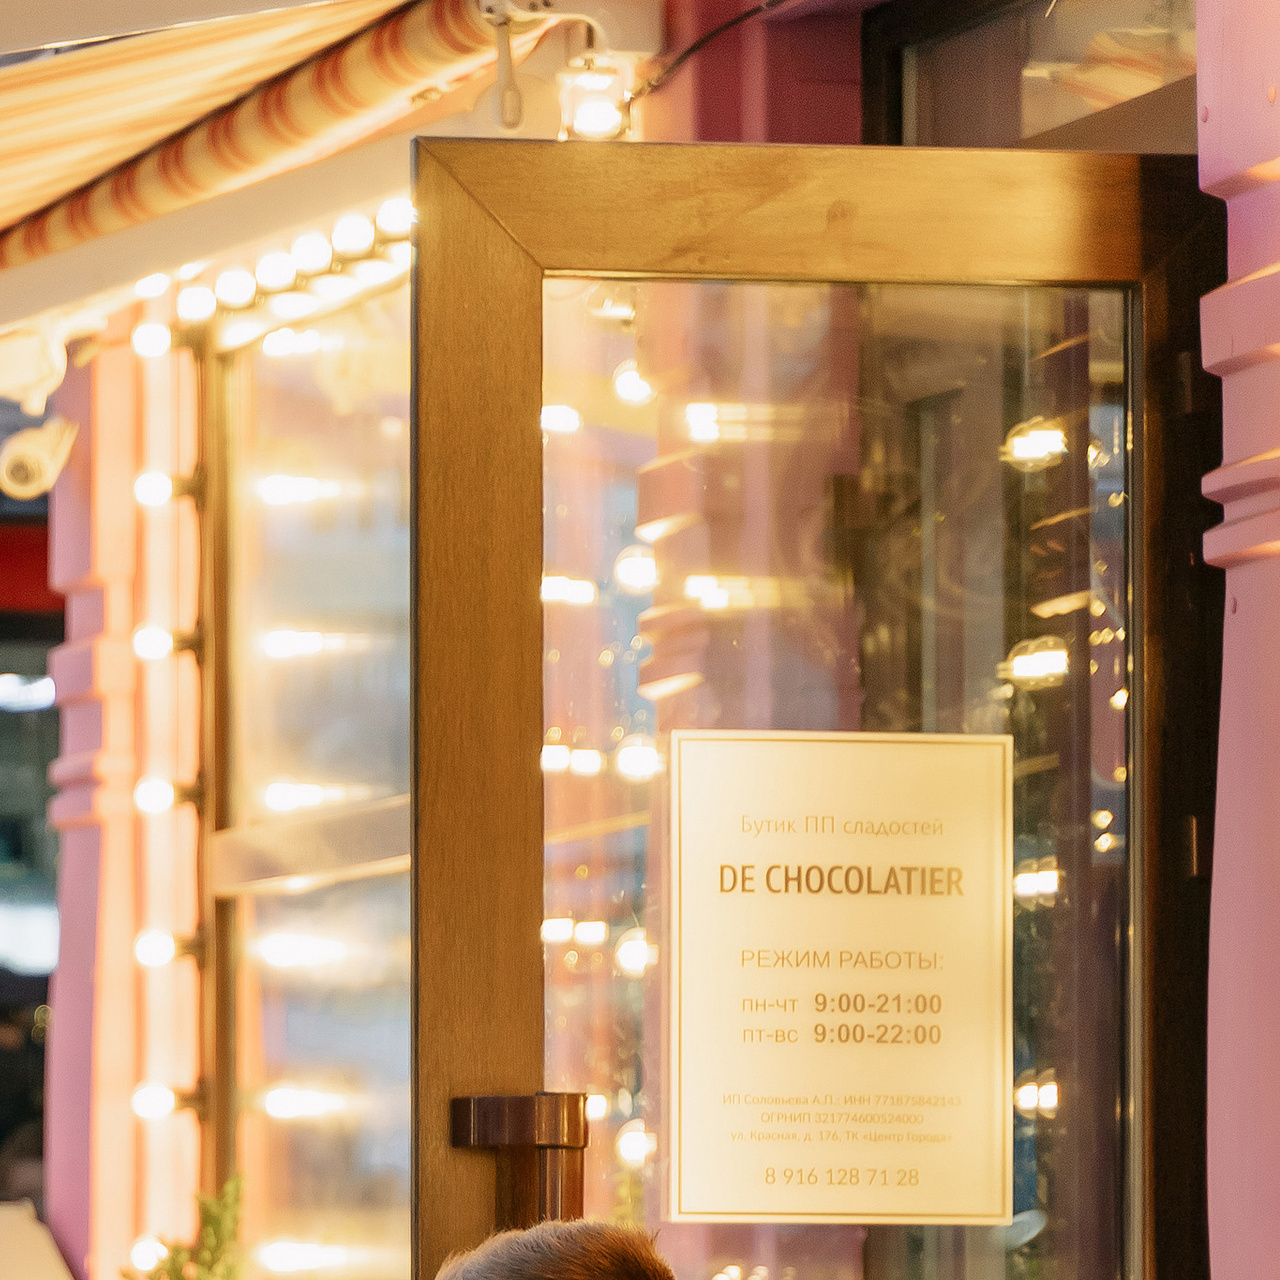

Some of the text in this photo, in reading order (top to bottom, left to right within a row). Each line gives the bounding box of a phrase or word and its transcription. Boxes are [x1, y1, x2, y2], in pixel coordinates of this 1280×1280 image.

[741, 814, 944, 837] Бутик ПП сладостей
[719, 863, 964, 896] DE CHOCOLATIER
[741, 949, 944, 970] РЕЖИМ РАБОТЫ:
[814, 992, 942, 1014] 9:00-21:00
[813, 1023, 941, 1044] 9:00-22:00
[764, 1167, 919, 1186] 8 916 128 71 28
